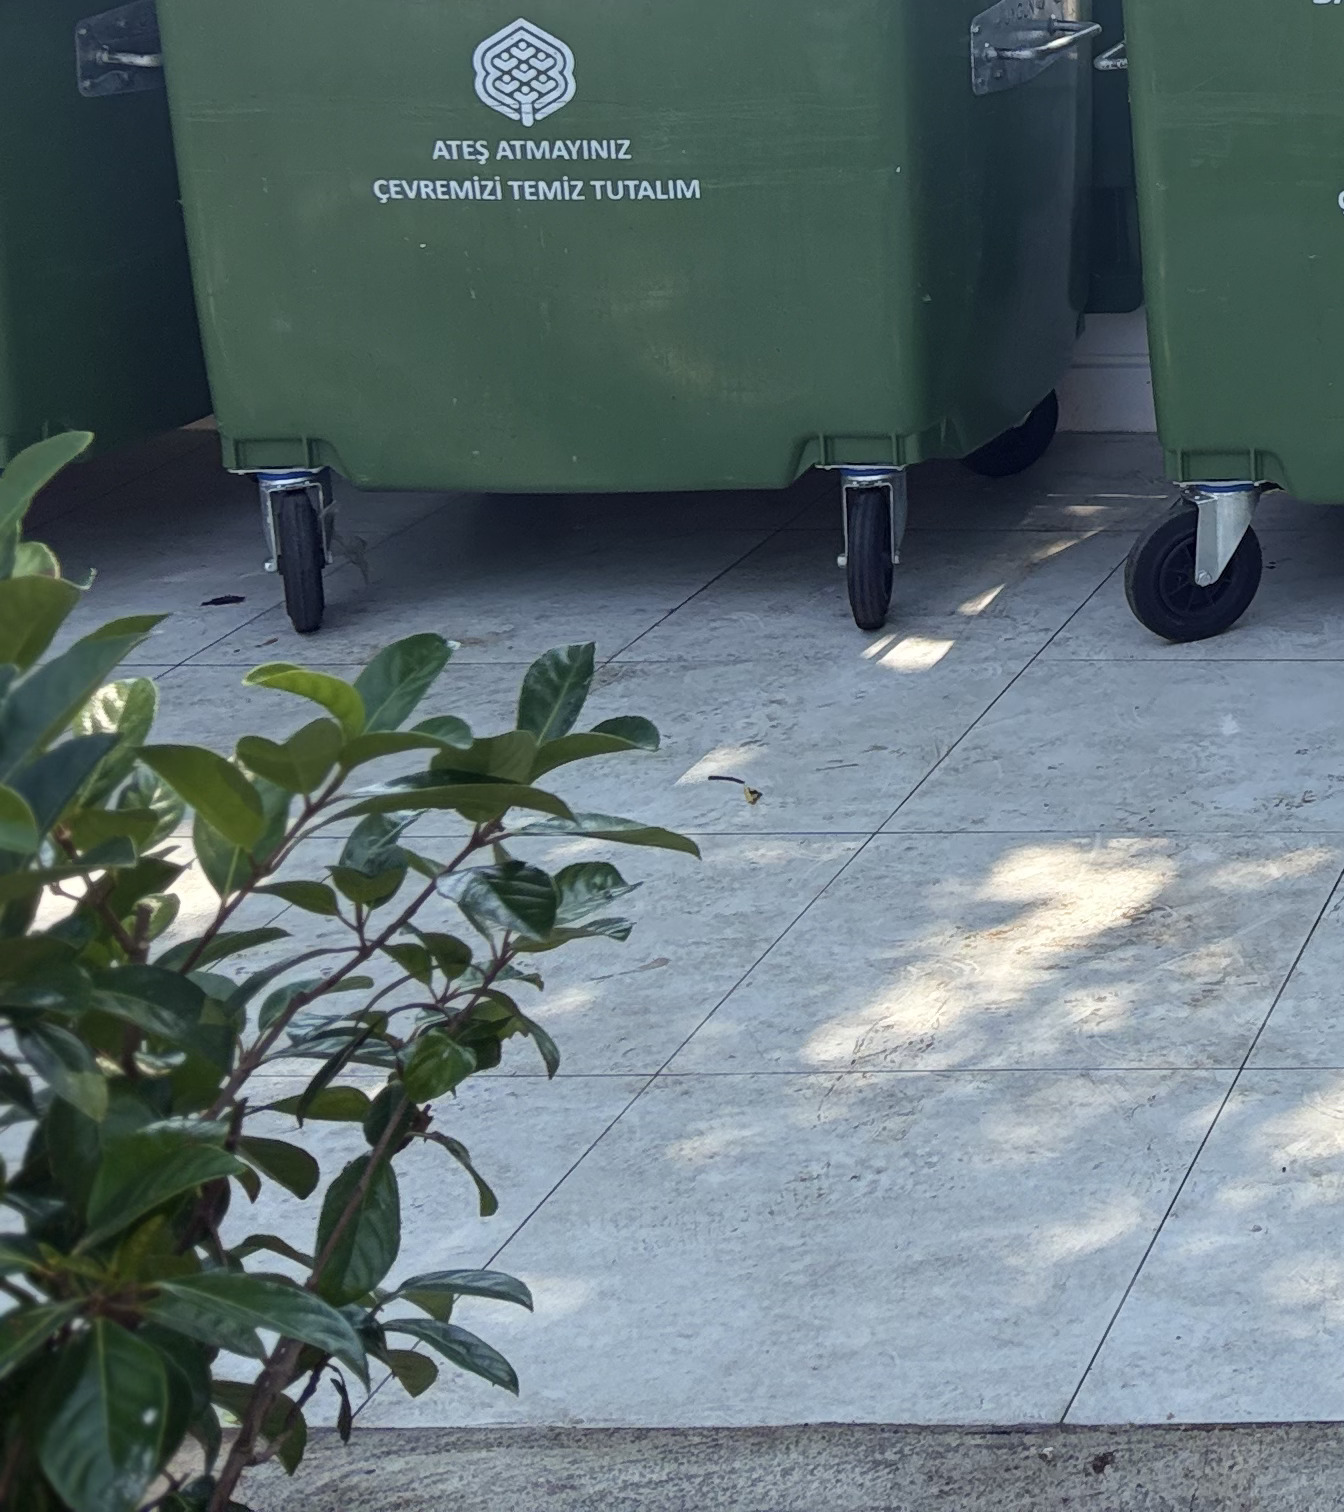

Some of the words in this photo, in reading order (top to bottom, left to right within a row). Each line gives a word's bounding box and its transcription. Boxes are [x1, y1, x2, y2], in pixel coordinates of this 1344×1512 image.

[432, 140, 490, 165] ATEŞ
[495, 139, 632, 161] ATMAYINIZ
[373, 175, 503, 204] ÇEVREMİZİ
[507, 175, 586, 201] TEMİZ
[589, 179, 701, 200] TUTALIM
